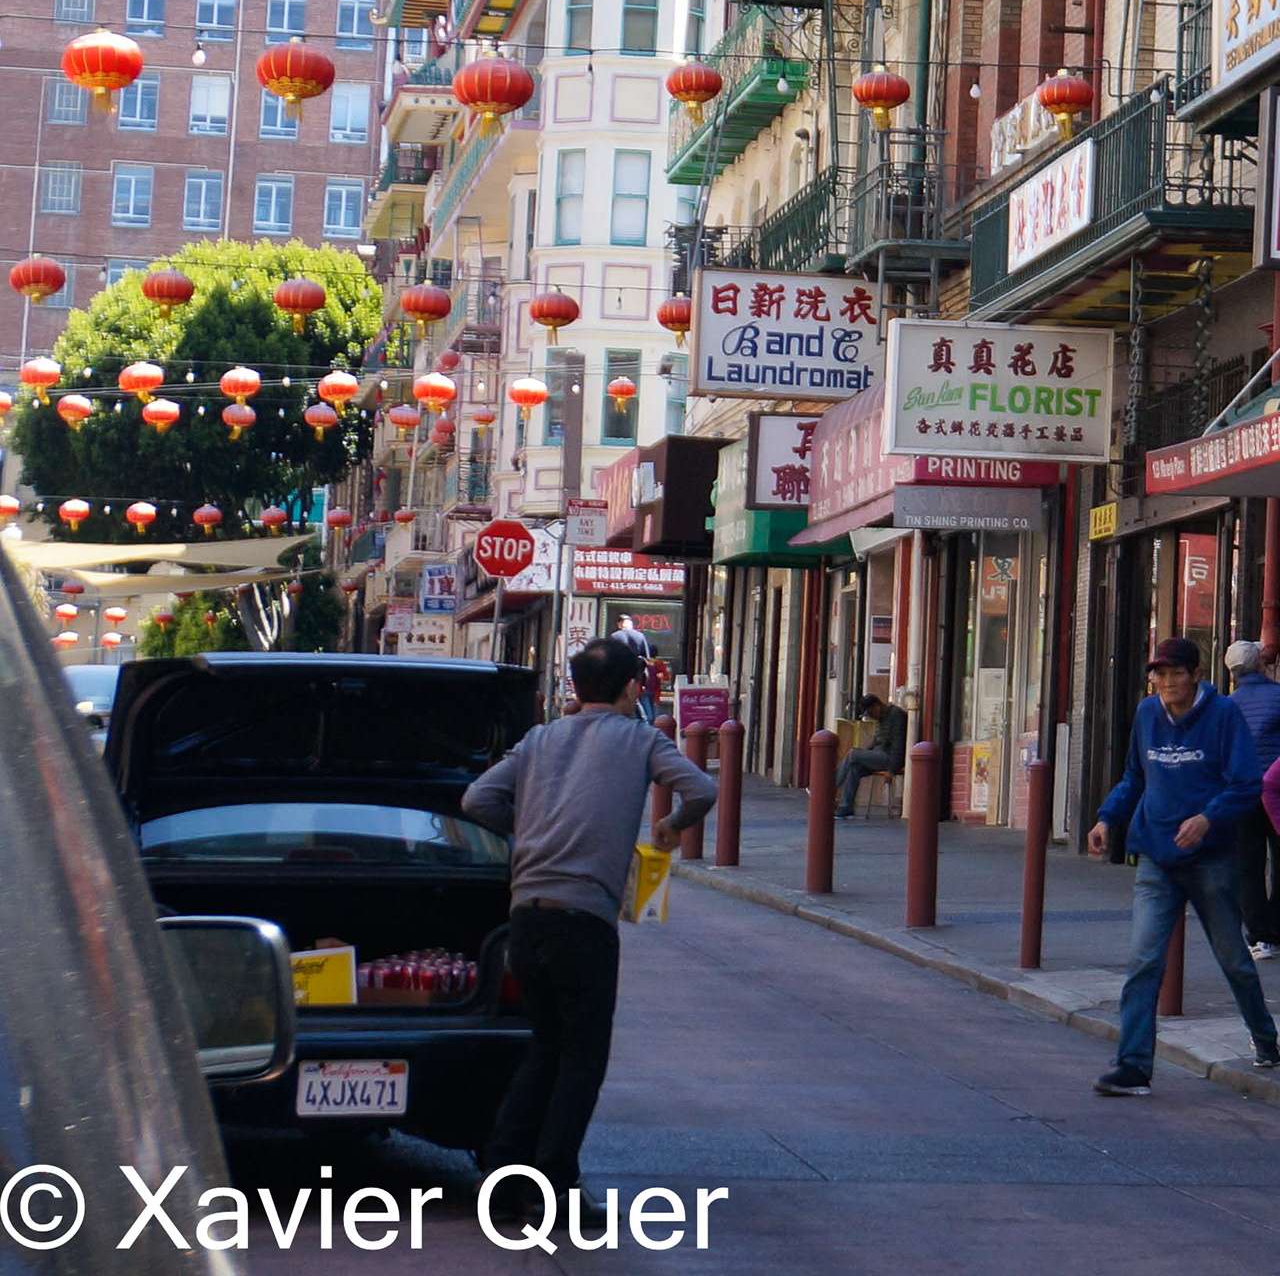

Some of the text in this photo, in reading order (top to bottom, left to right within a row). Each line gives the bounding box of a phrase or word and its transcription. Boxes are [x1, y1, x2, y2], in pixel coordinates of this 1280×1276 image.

[710, 282, 878, 325] 日新洗衣
[766, 325, 825, 358] and
[927, 336, 1078, 379] 真真花店
[706, 355, 874, 390] Laundromat
[968, 381, 1102, 418] FLORIST
[927, 456, 1021, 481] PRINTING
[923, 514, 957, 528] SHING
[960, 515, 1008, 529] PRINTING
[479, 535, 532, 563] STOP
[304, 1079, 399, 1107] 4XJX471
